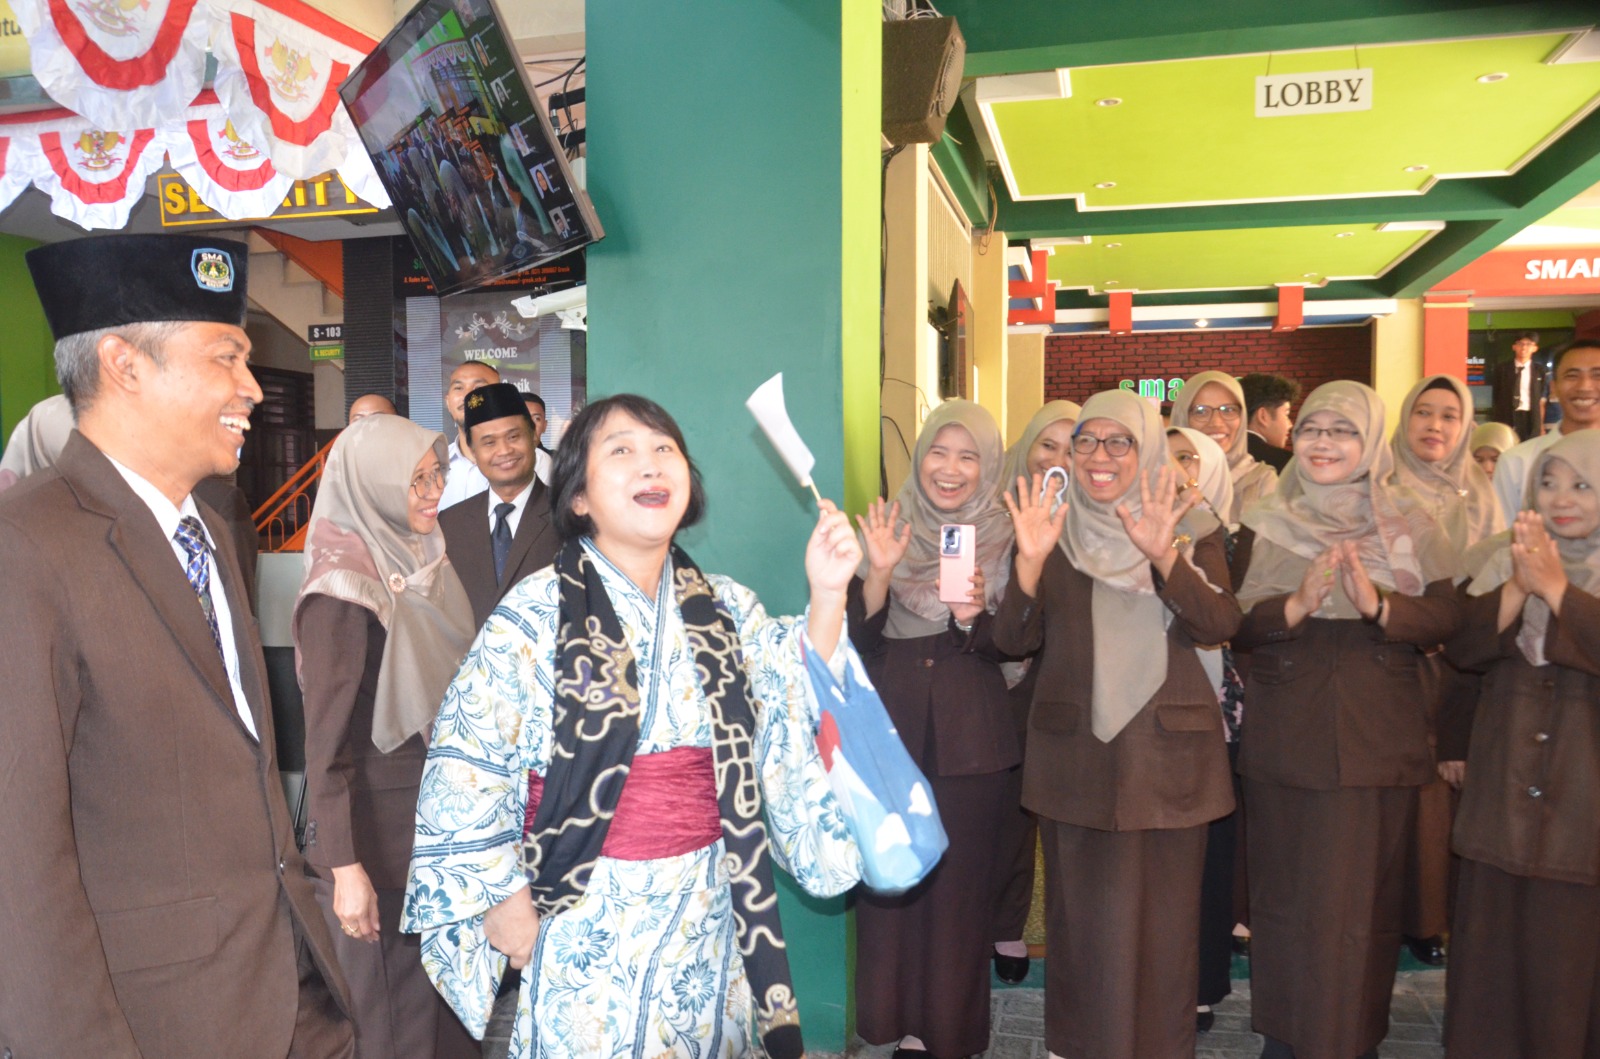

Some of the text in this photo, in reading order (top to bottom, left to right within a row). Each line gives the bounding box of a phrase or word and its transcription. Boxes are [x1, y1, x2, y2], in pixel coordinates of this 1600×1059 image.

[1263, 78, 1364, 108] LOBBY
[201, 252, 223, 262] SMA
[464, 347, 518, 361] WELCOME
